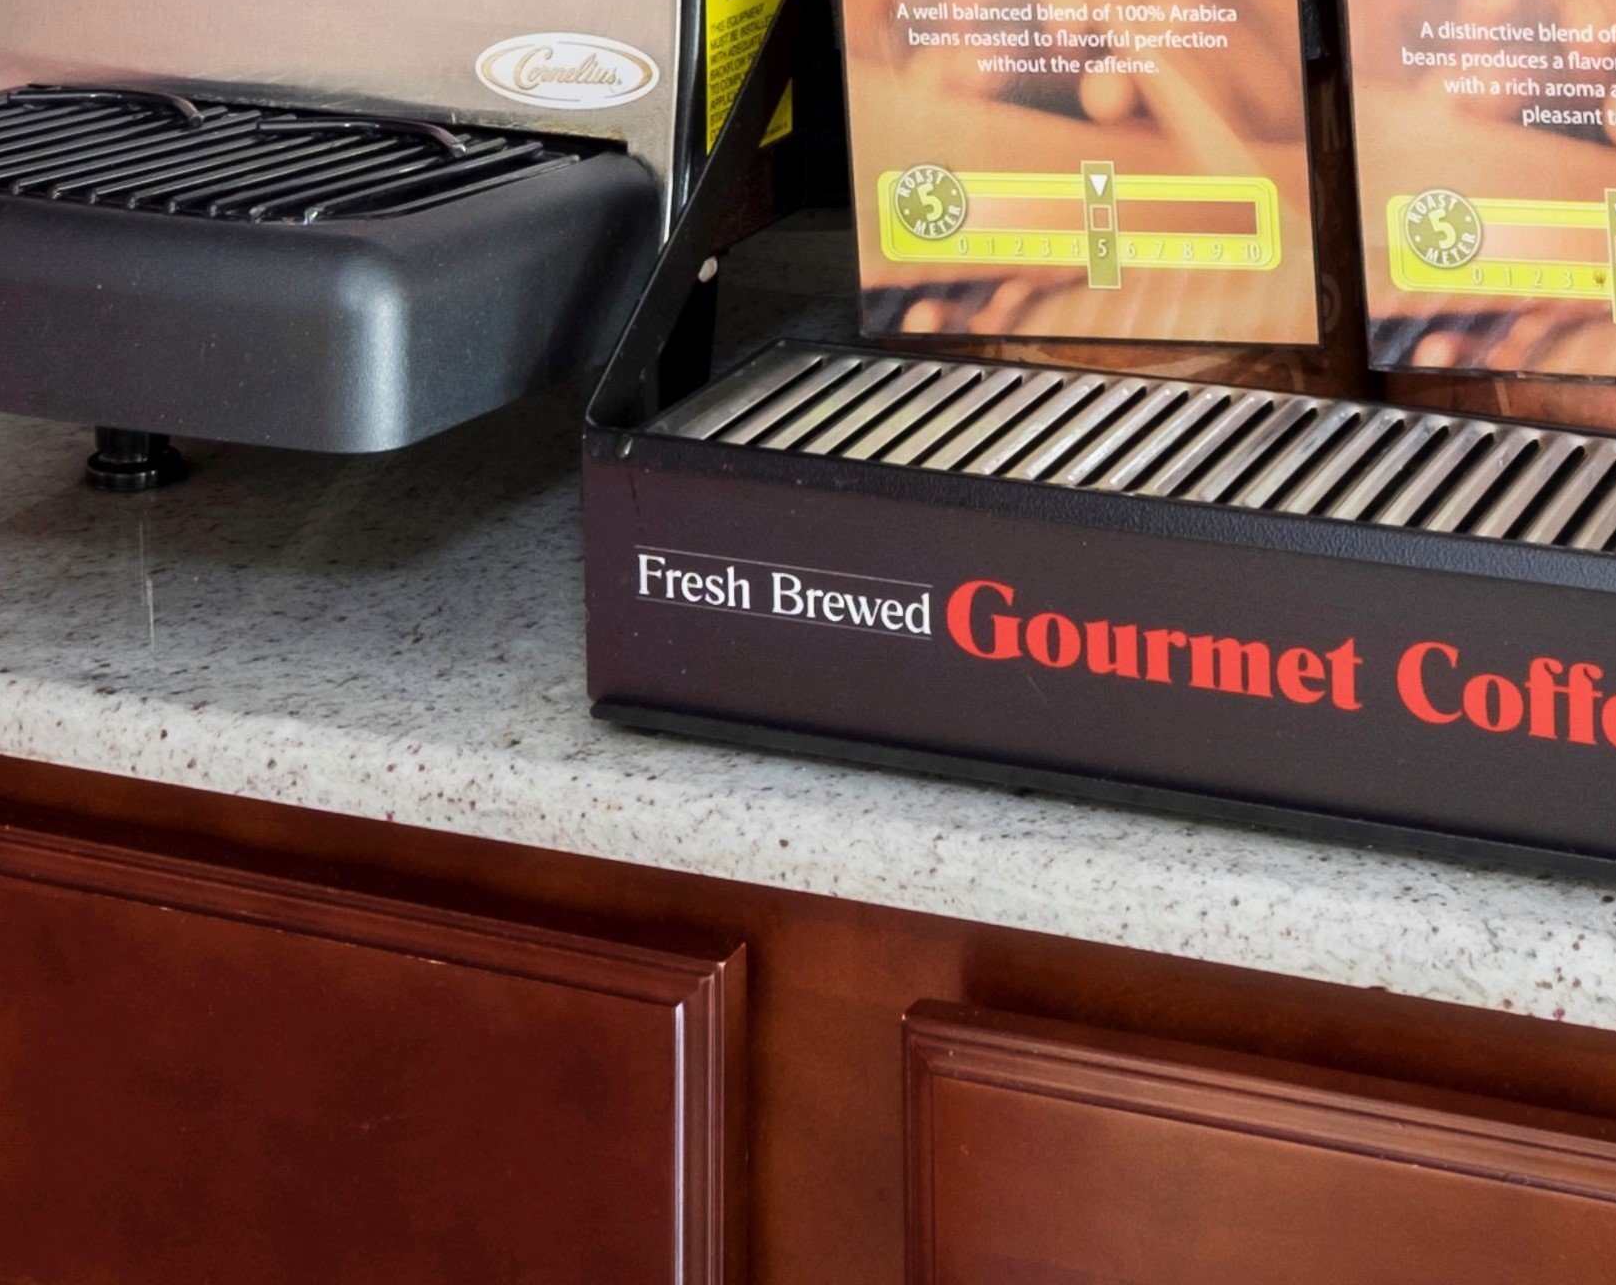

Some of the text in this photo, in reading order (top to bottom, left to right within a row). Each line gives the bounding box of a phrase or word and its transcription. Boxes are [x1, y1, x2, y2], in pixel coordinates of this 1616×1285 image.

[897, 3, 1237, 23] A well balanced blend of 100% Arabica
[908, 28, 1228, 52] beans roasted to flavorful perfection
[1420, 21, 1434, 38] A
[1438, 21, 1534, 42] distinctive
[1538, 22, 1593, 43] blend
[977, 55, 1160, 74] without the caffeine.
[1401, 47, 1457, 66] beans
[1461, 50, 1548, 71] produces
[1552, 56, 1564, 69] a
[1444, 76, 1485, 95] with
[1489, 82, 1500, 95] a
[1505, 77, 1540, 96] rich
[1544, 84, 1605, 98] aroma
[1522, 105, 1603, 127] pleasant
[898, 169, 945, 198] ROAST
[916, 181, 943, 222] 5
[1408, 194, 1458, 224] ROAST
[914, 204, 961, 237] METER
[1428, 207, 1457, 250] 5
[1097, 238, 1107, 258] 5
[1425, 232, 1477, 265] METER
[636, 554, 752, 611] Fresh
[772, 574, 932, 636] Brewed
[945, 579, 1363, 711] Gourmet
